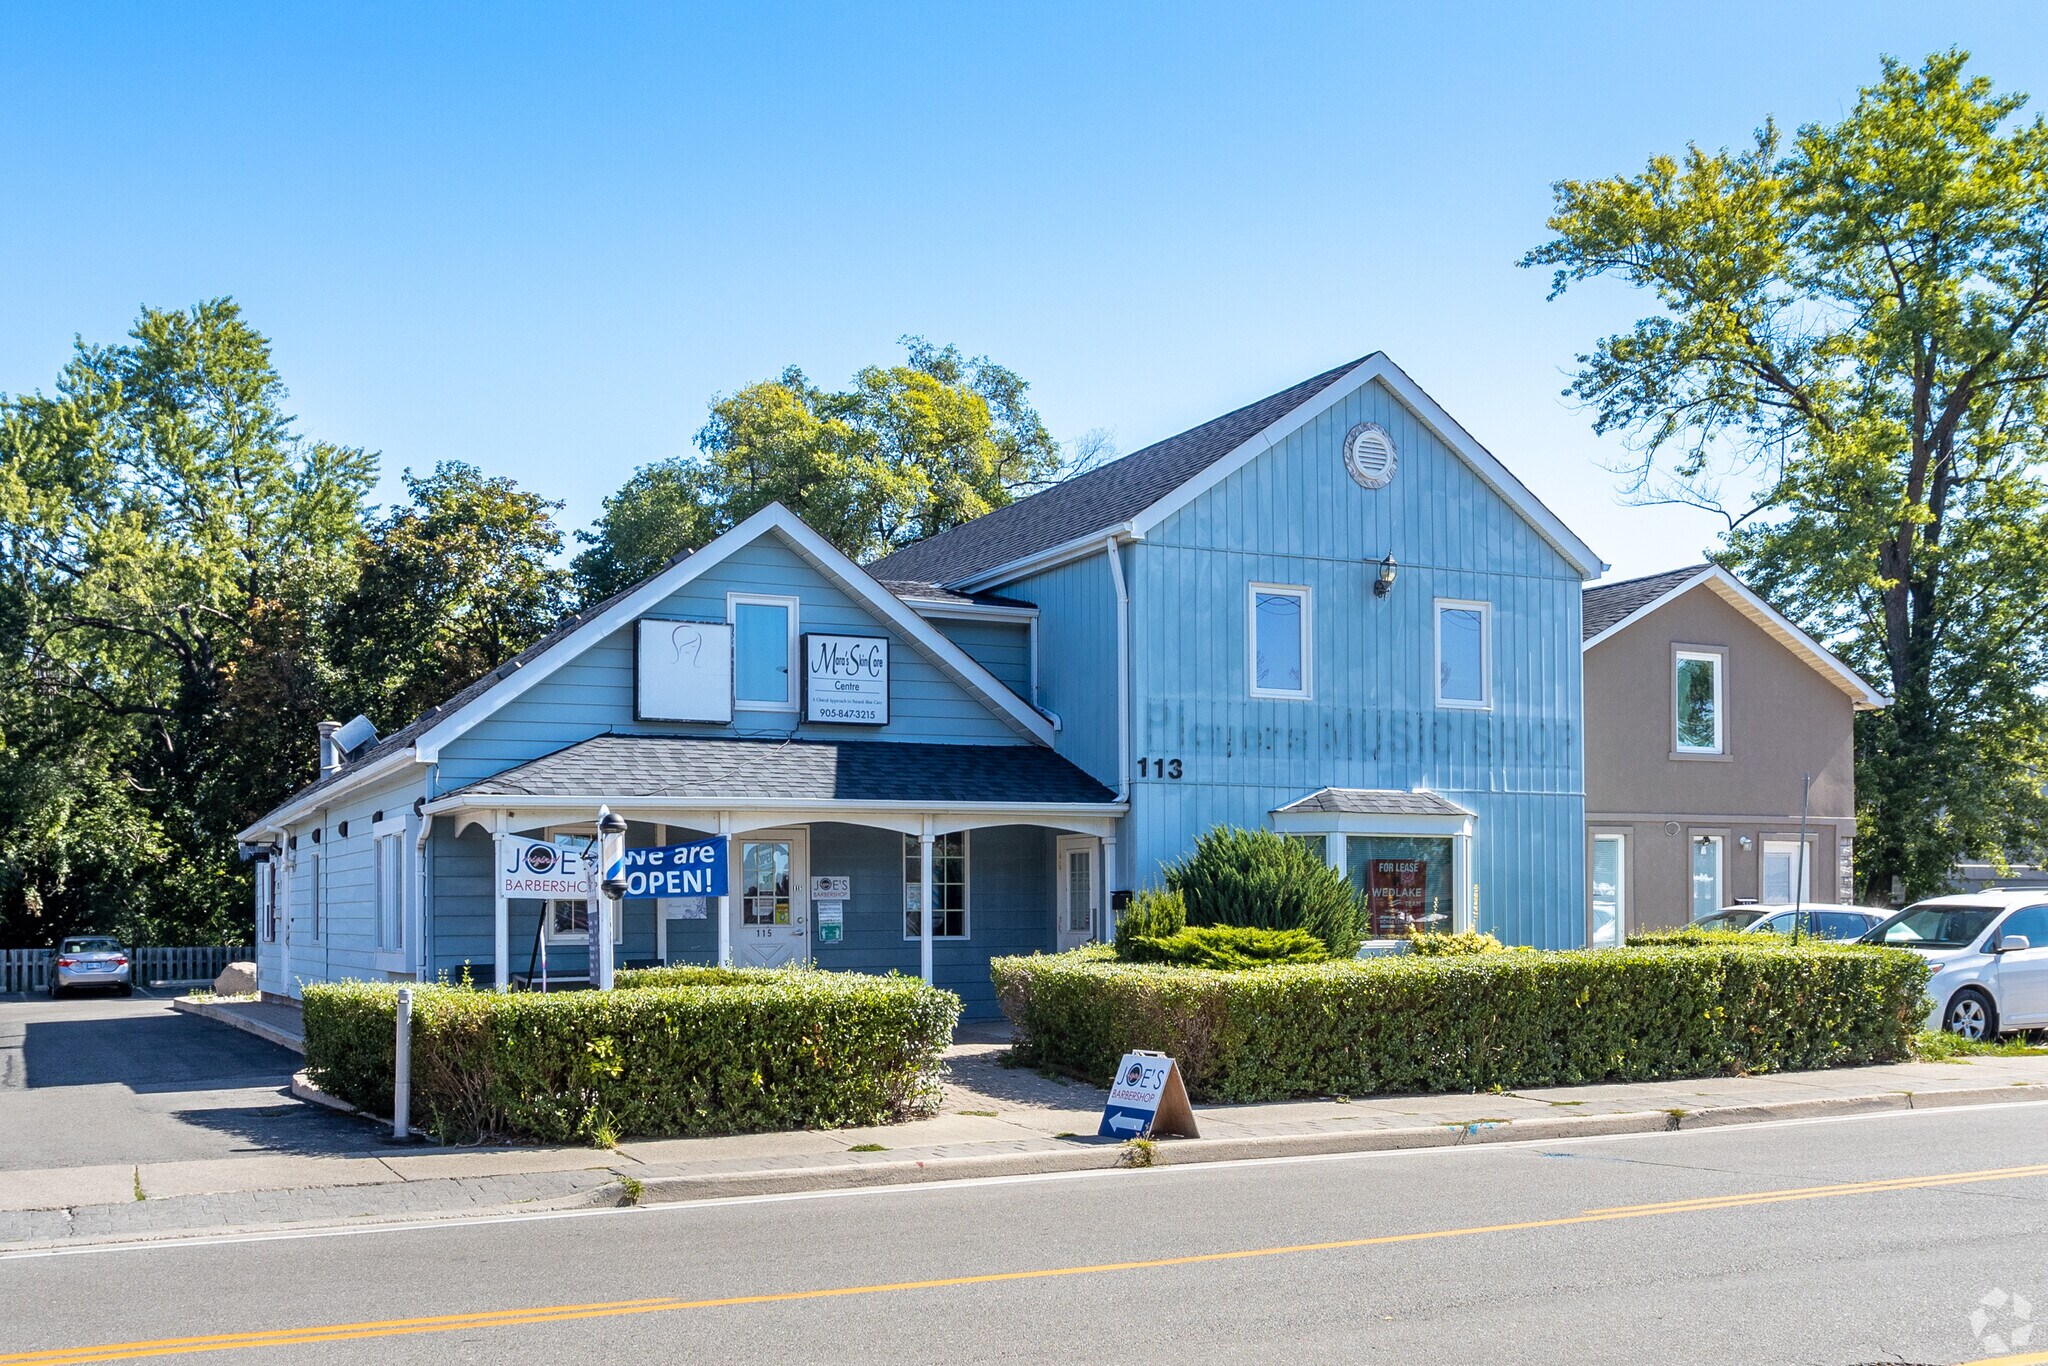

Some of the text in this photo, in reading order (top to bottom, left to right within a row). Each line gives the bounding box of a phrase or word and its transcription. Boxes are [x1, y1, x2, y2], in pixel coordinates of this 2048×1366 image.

[812, 642, 883, 677] Mara's Skin Care
[834, 681, 860, 691] Centre
[820, 708, 876, 719] 905-847-3215
[1137, 757, 1183, 779] 113
[673, 845, 715, 865] are
[1379, 862, 1419, 873] FOR LEASE
[627, 867, 712, 895] OPEN!
[814, 877, 848, 891] JOE'S
[1372, 887, 1422, 897] WEDLAKE
[756, 929, 772, 938] 115
[1116, 1062, 1165, 1090] JOE'S
[1111, 1089, 1156, 1103] BARBERSHOP
